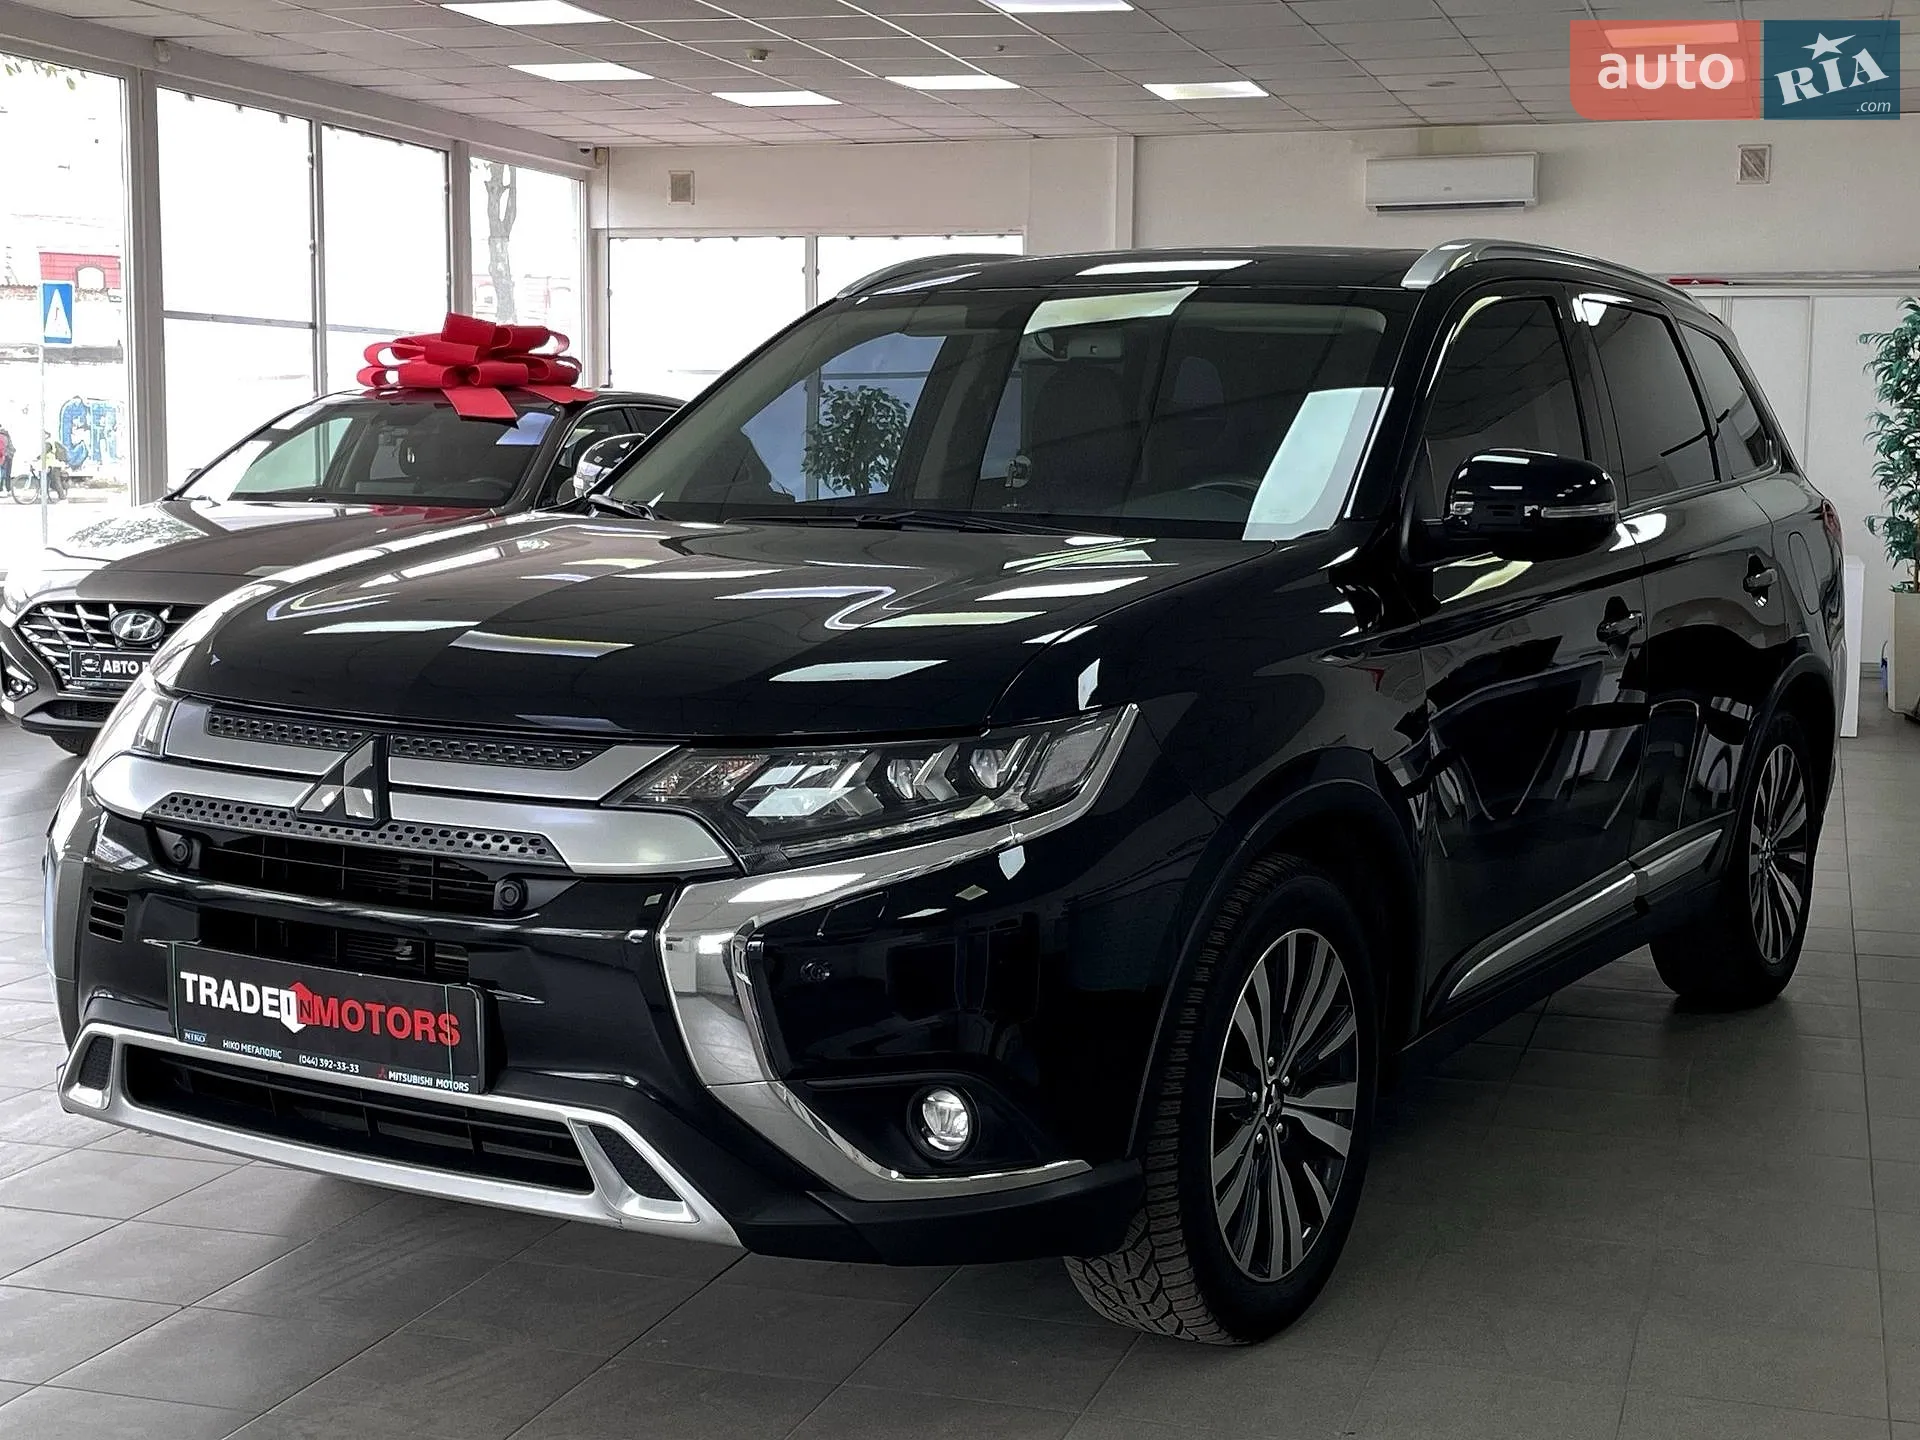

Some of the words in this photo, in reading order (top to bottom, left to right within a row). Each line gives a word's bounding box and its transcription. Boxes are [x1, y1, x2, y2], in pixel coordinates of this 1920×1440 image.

[102, 659, 139, 675] АВТО
[180, 971, 281, 1019] TRADE
[313, 994, 461, 1047] MOTORS
[184, 1032, 206, 1043] NIKO
[241, 1043, 282, 1060] МЕГАПОЛІС
[298, 1054, 318, 1068] (044)
[319, 1058, 360, 1074] 392-33-33
[388, 1070, 433, 1087] MITSUBISHI
[435, 1077, 470, 1093] MOTORS
